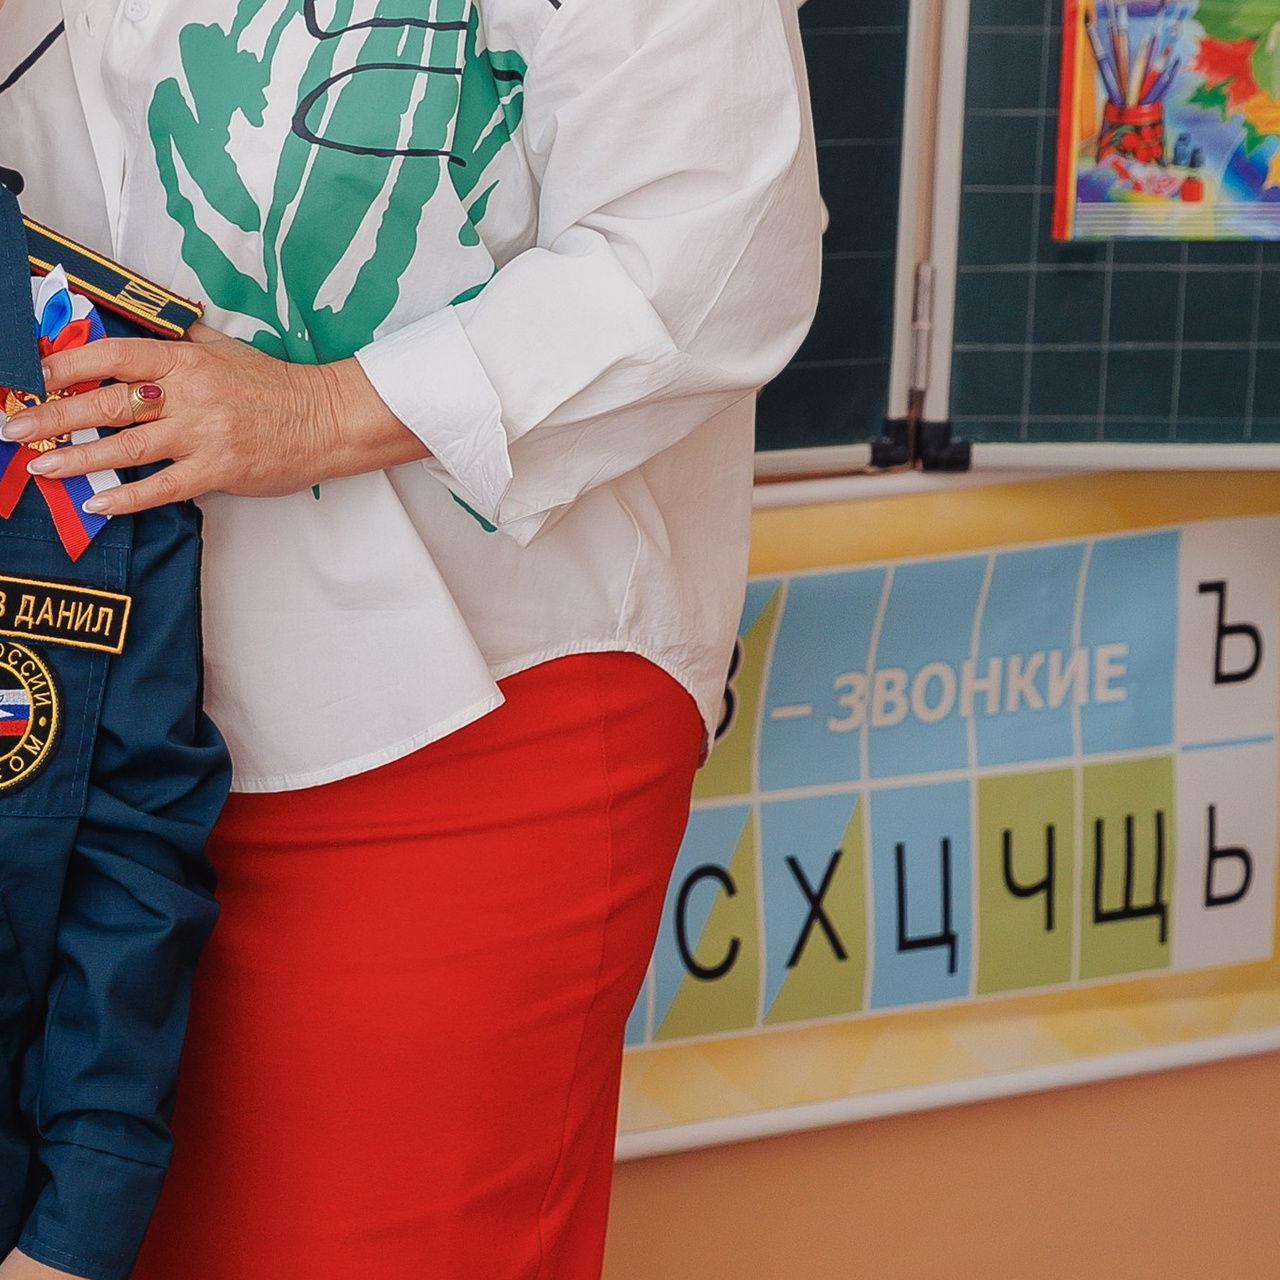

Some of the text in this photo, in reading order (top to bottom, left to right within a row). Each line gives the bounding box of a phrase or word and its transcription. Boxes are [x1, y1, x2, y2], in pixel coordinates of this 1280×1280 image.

[14, 594, 114, 637] ДАНИЛ
[1198, 580, 1264, 686] Ъ
[827, 644, 1129, 734] ЗВОНКИЕ
[674, 809, 1168, 983] С Х Ц Ч Щ
[1203, 803, 1254, 909] Ь
